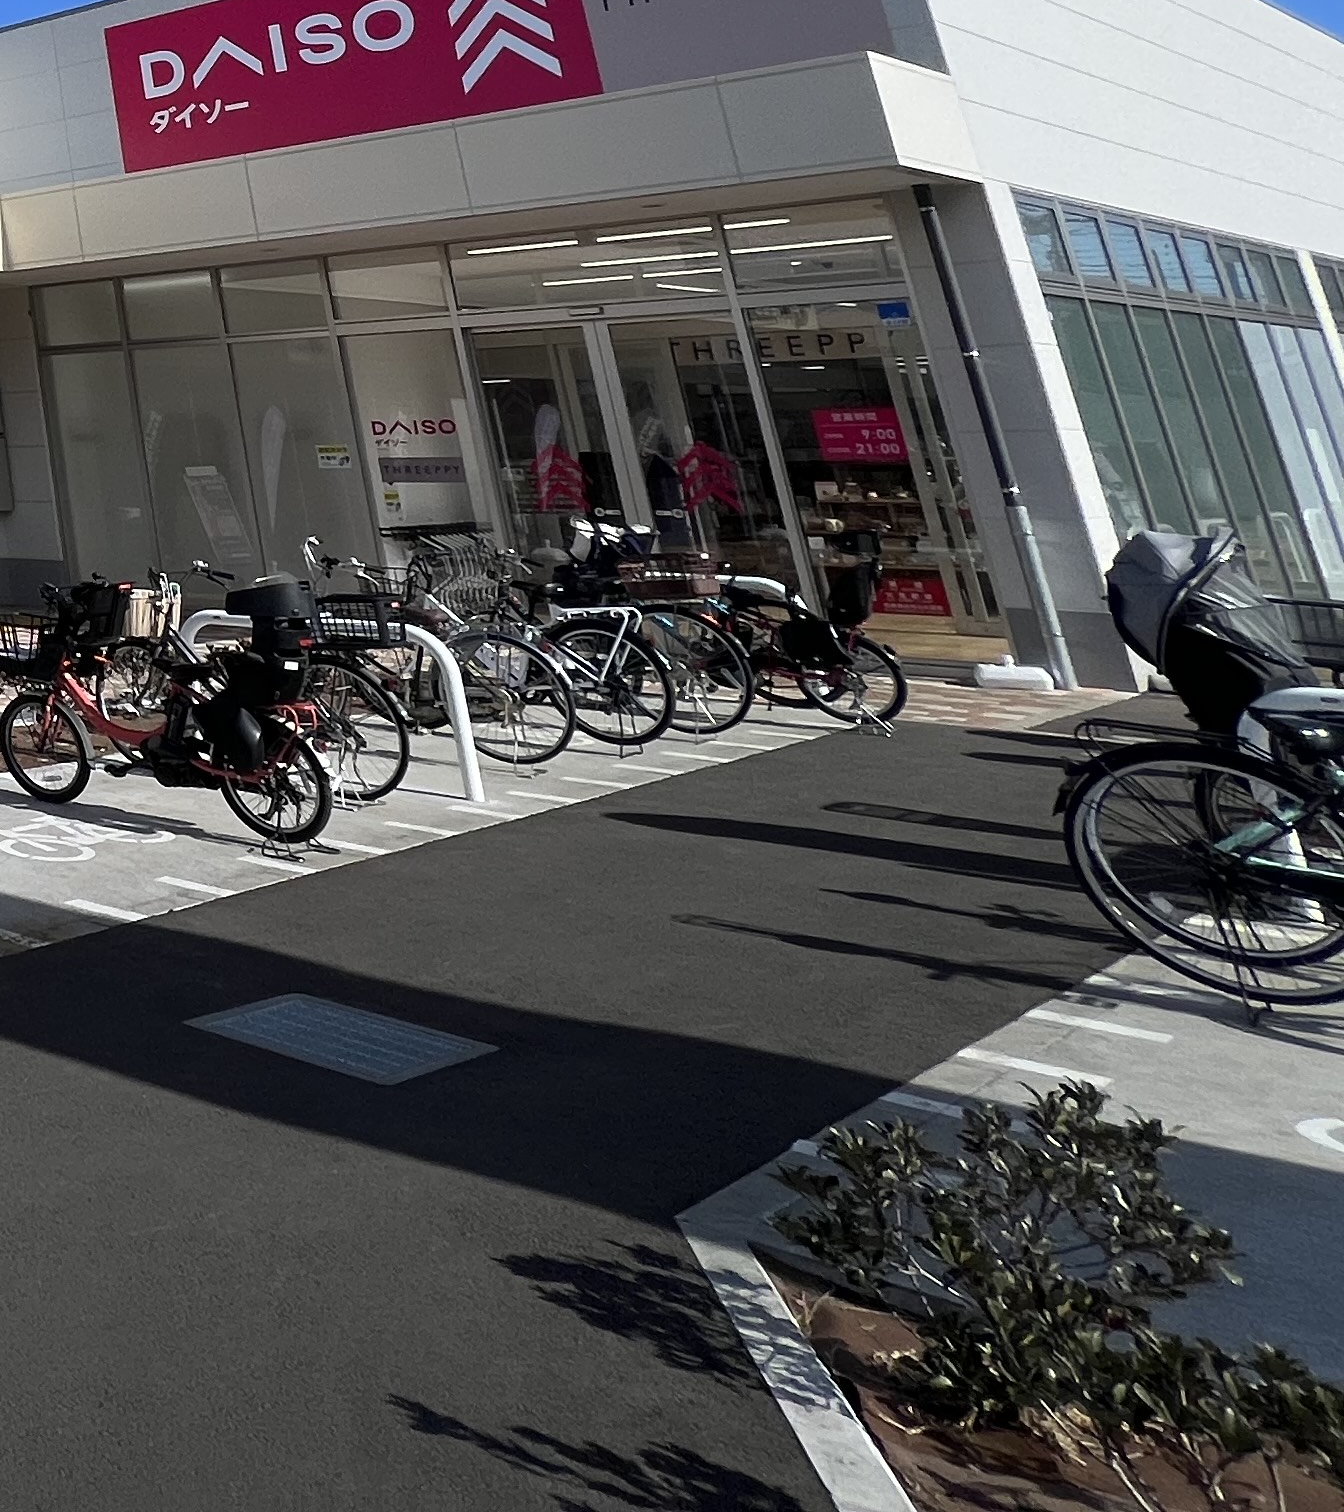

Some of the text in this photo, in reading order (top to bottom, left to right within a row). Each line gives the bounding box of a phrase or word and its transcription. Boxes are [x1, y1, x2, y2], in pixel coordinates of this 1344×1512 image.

[149, 98, 251, 135] ダイソー
[371, 419, 456, 436] DAISO
[861, 429, 896, 440] 9:00
[855, 443, 900, 455] 21:00
